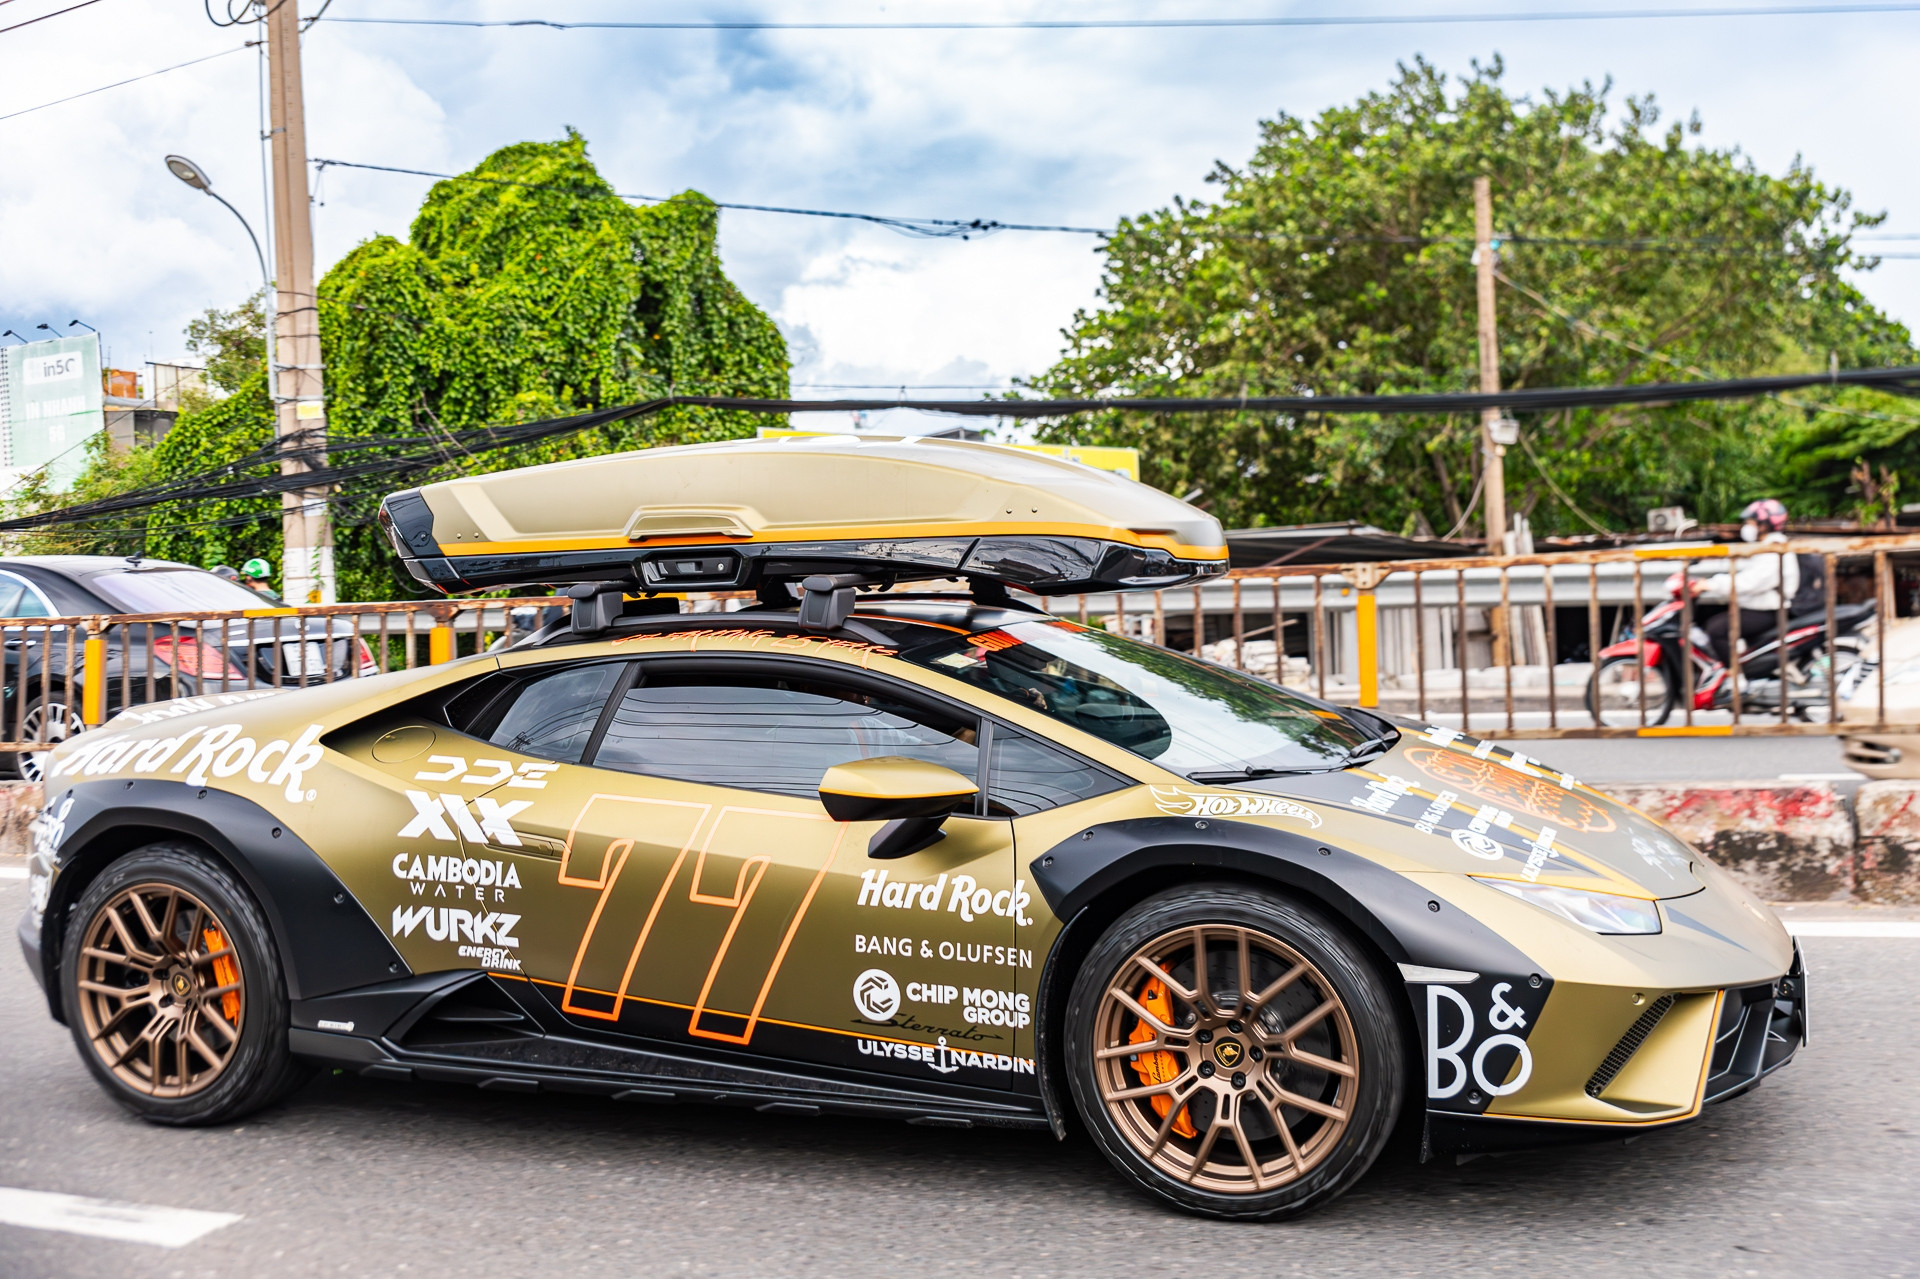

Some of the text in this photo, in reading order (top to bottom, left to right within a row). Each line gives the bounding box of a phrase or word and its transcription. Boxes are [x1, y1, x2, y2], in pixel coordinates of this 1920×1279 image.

[50, 726, 208, 778] Hard
[392, 852, 522, 889] CAMBODIA
[410, 881, 505, 903] WATER
[857, 869, 949, 912] Hard
[392, 905, 522, 948] WURKZ
[458, 945, 509, 960] ENERGY
[481, 956, 522, 971] DRINK
[855, 934, 1033, 969] BANG & OLUFSEN
[905, 982, 1031, 1013] CHIP MONG
[855, 1013, 1003, 1042] Sterrato
[963, 1006, 1032, 1029] GROUP
[857, 1039, 1035, 1075] ULYSSE NARDIN
